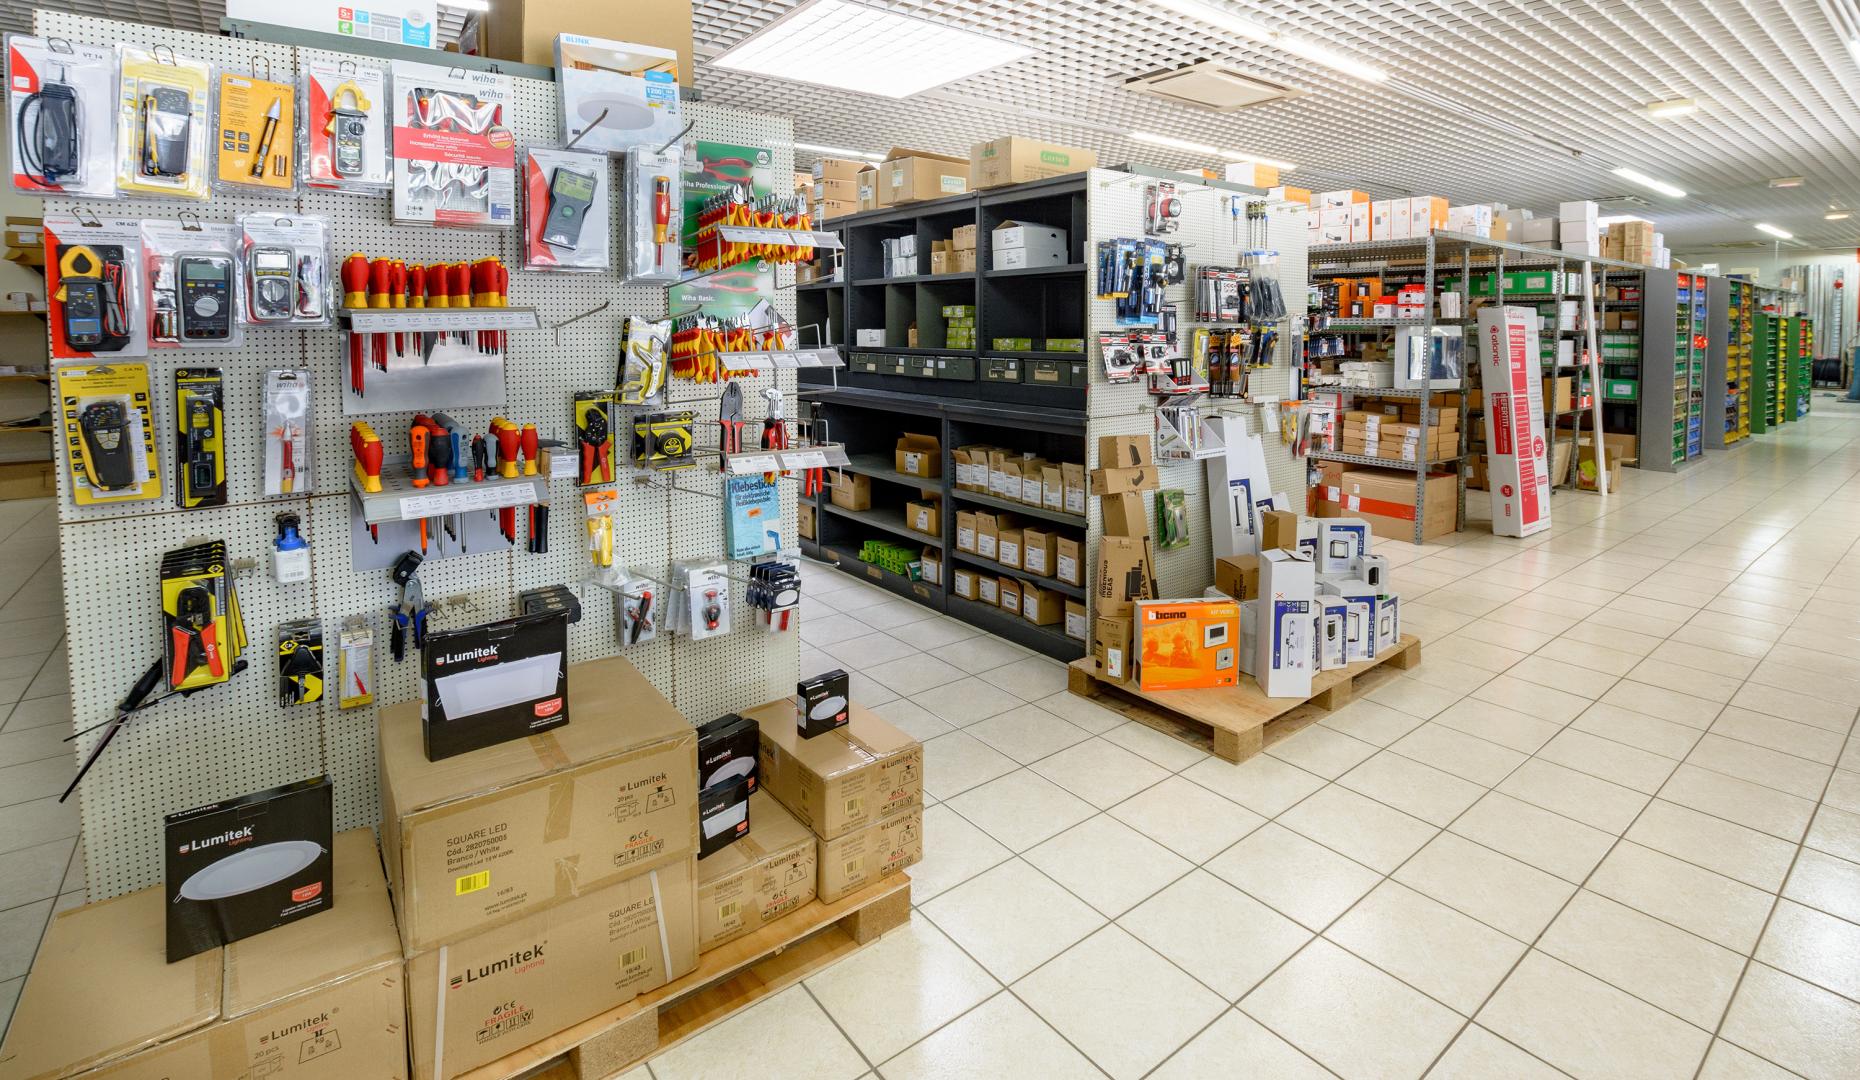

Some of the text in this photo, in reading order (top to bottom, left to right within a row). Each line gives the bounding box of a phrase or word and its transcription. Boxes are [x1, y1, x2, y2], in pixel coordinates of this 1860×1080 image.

[472, 73, 496, 84] wiha
[479, 88, 503, 99] wiha
[1491, 334, 1500, 366] atlantic
[1148, 610, 1187, 620] bticino
[446, 645, 499, 664] Lumitek
[887, 754, 913, 768] Lumitek
[627, 771, 667, 791] Lumitek
[886, 815, 913, 829] Lumitek
[192, 826, 253, 851] Lumitek
[446, 822, 508, 847] SQUARE LED
[624, 835, 656, 849] FRAGILE
[446, 846, 464, 857] Cód.
[447, 853, 474, 866] Branco
[480, 845, 500, 856] White
[769, 850, 801, 869] Lumitek
[608, 896, 655, 920] SQUARE LE
[466, 944, 545, 983] Lumitek
[514, 959, 545, 974] Lighting
[484, 1005, 526, 1027] FRAGILE
[271, 1013, 329, 1041] Lumitek
[314, 1037, 325, 1045] kg
[254, 1046, 279, 1060] 20 pcs
